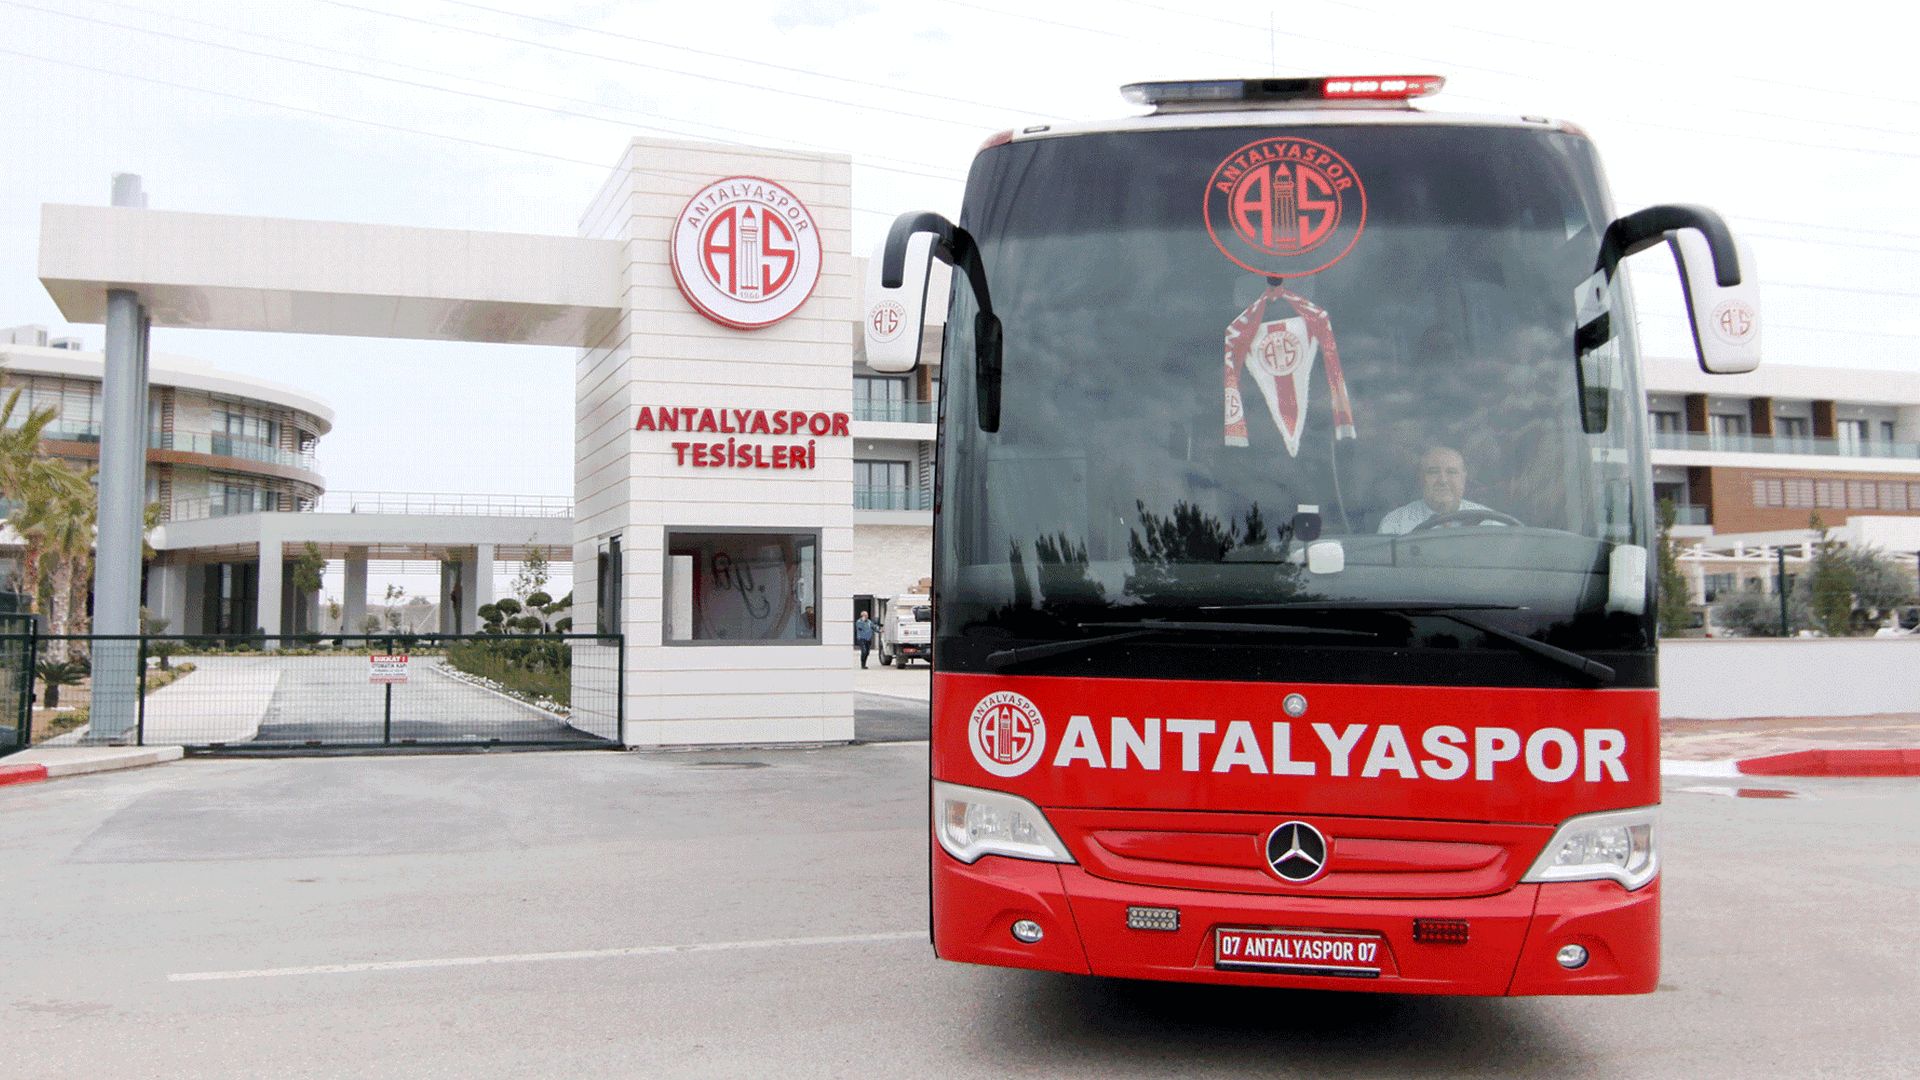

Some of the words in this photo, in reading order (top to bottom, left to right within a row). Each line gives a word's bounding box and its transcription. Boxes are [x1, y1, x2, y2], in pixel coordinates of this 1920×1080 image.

[1215, 143, 1353, 195] ANTALYASPOR
[688, 183, 809, 232] ANTALYASPOR
[636, 406, 849, 437] ANTALYASPOR
[672, 437, 816, 470] TESİSLERİ
[973, 694, 1041, 727] ANTALYASPOR
[1052, 715, 1630, 783] ANTALYASPOR
[1222, 935, 1241, 956] 07
[1244, 937, 1354, 961] ANTALYASPOR
[1357, 942, 1377, 962] 07
